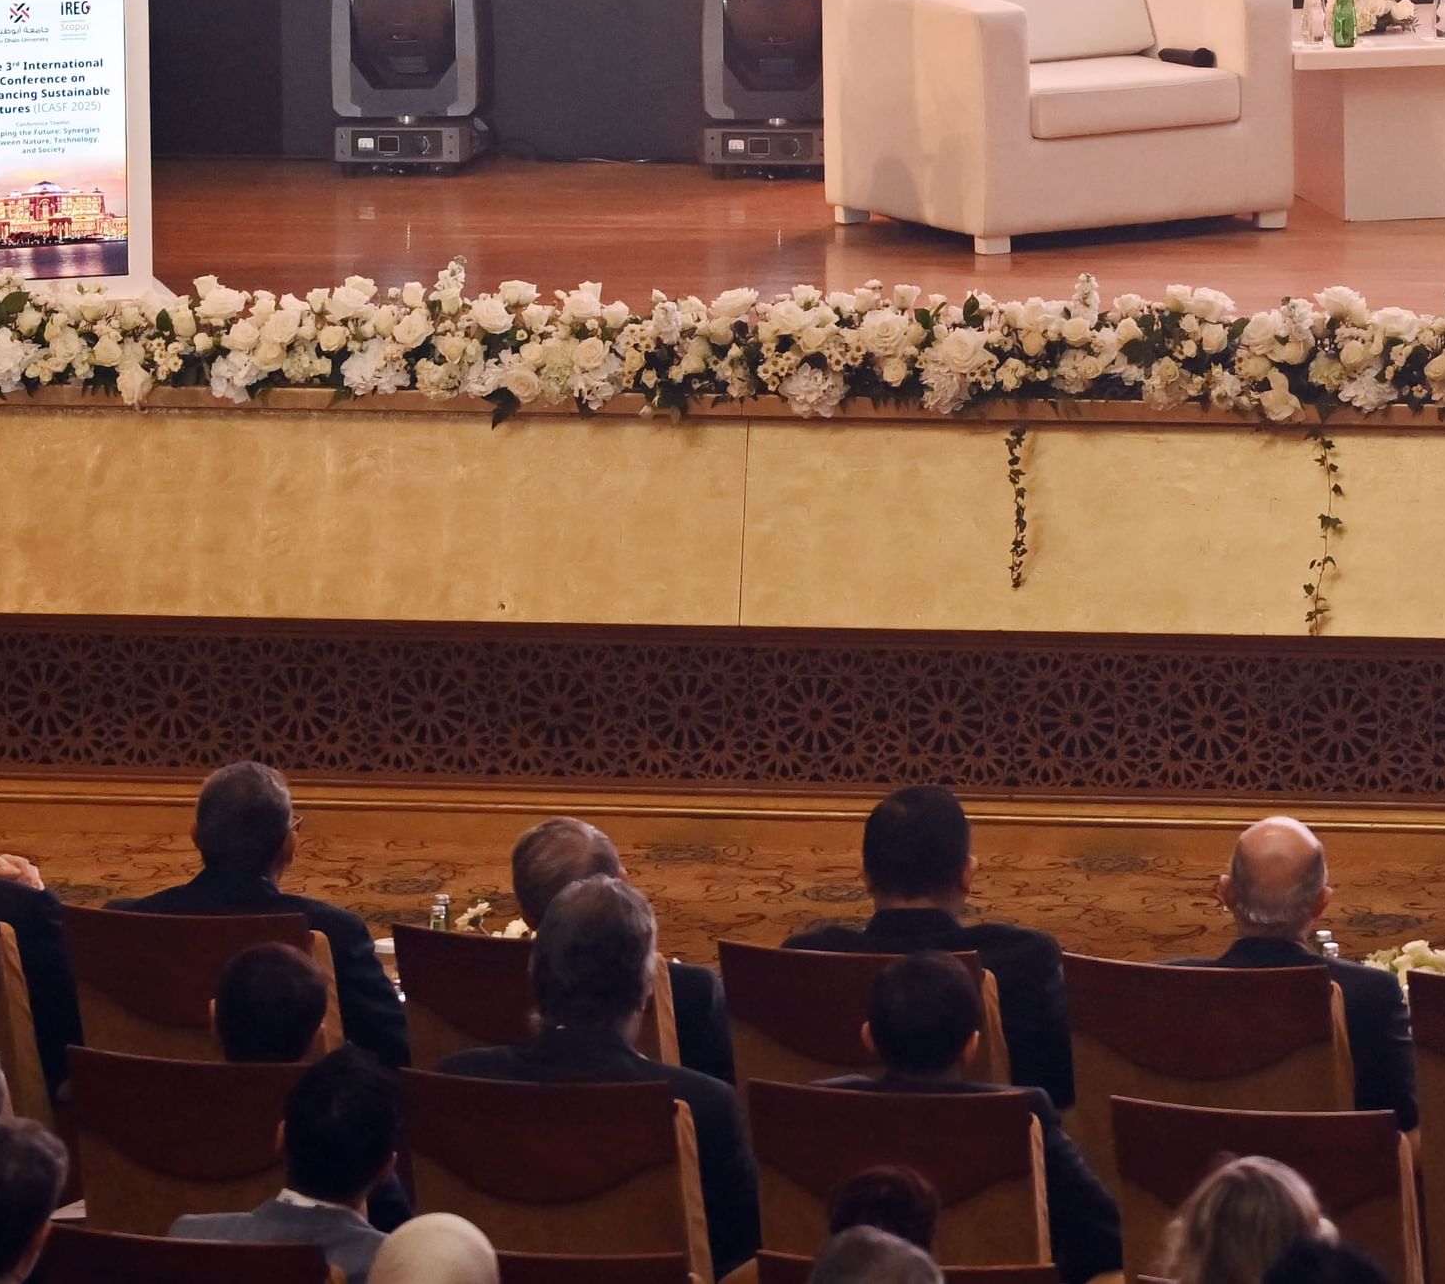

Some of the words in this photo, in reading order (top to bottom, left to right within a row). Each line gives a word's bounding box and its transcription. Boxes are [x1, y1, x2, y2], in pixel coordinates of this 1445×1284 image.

[23, 58, 103, 71] International
[0, 75, 68, 86] Conference
[70, 74, 86, 83] on
[40, 86, 111, 99] Sustainable
[71, 100, 102, 113] 2025)
